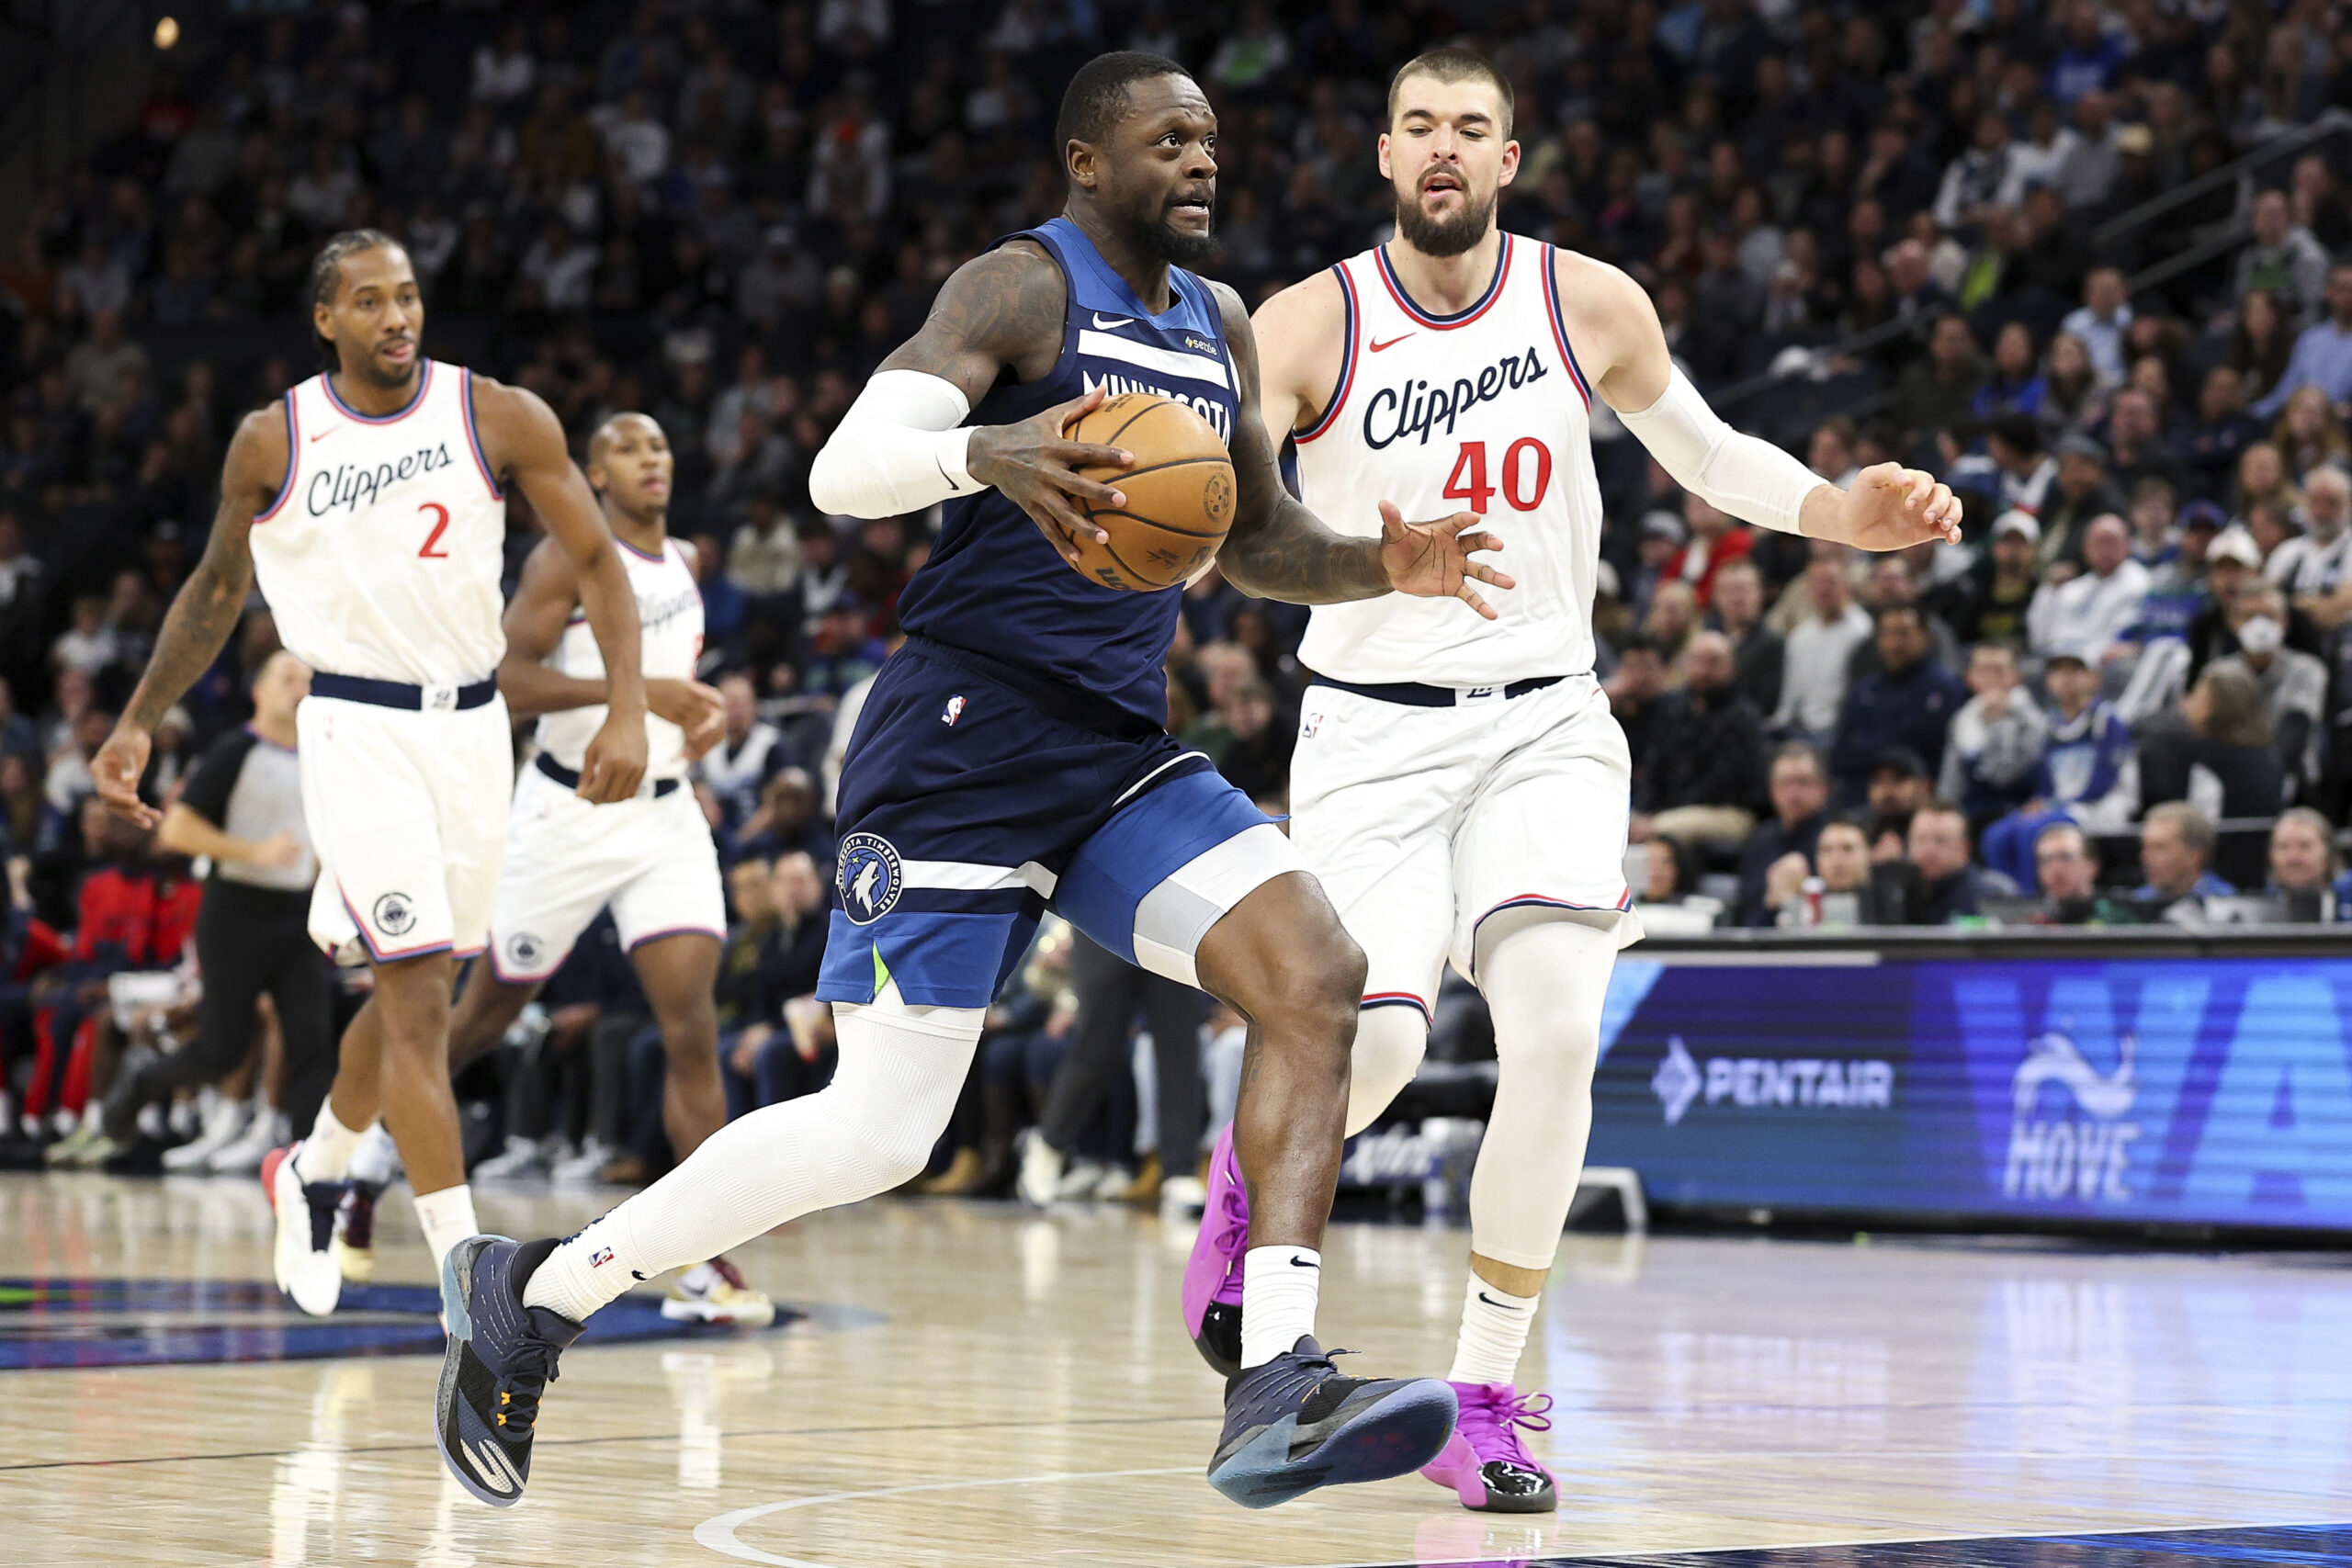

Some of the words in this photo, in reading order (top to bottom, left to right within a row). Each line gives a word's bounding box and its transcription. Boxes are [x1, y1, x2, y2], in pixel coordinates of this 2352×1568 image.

[1193, 339, 1218, 355] sezzle
[1363, 346, 1548, 450] Clippers
[308, 442, 453, 516] Clippers
[1442, 436, 1552, 514] 40
[418, 502, 449, 558] 2
[866, 838, 900, 911] TIMBERWOLVES
[1705, 1057, 1894, 1107] PENTAIR
